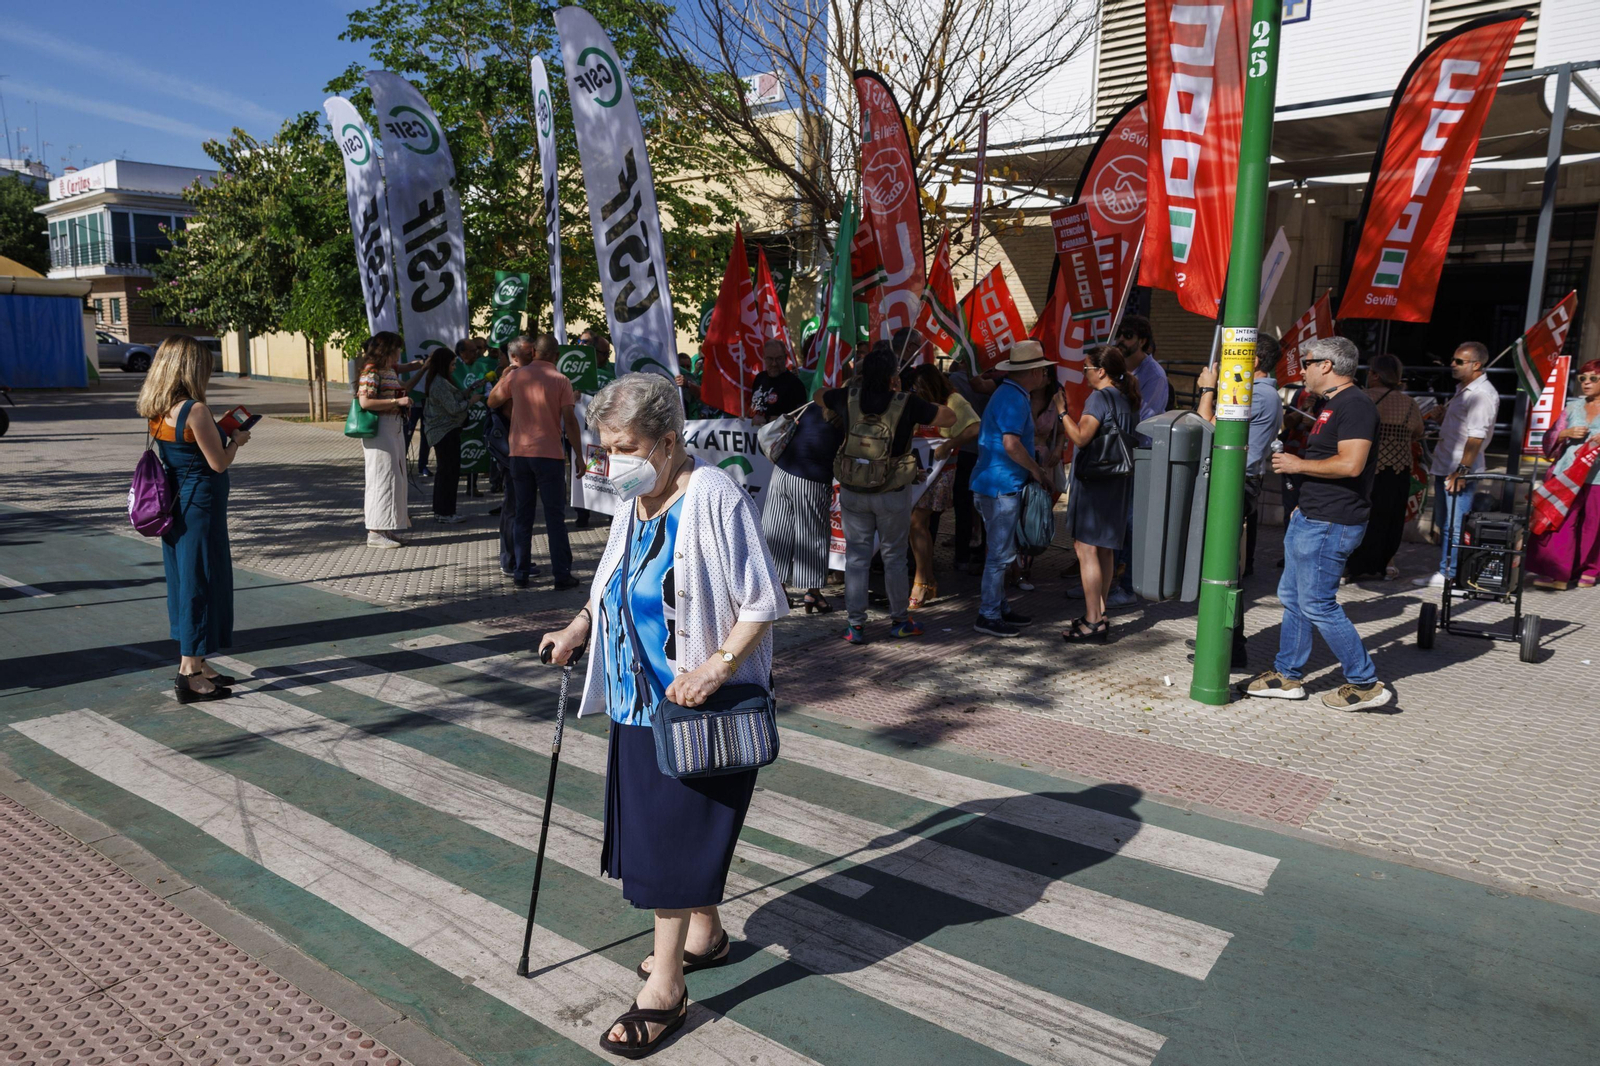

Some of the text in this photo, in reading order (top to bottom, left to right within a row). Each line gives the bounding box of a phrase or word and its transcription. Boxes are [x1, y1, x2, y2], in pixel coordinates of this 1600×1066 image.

[1249, 21, 1270, 78] 25
[1052, 212, 1089, 228] SALVEMOS LA
[1060, 224, 1086, 238] ATENCIÓN
[1062, 236, 1088, 250] PRIMARIA
[1071, 252, 1094, 309] CCOO
[499, 283, 524, 297] CSIF
[1364, 292, 1398, 306] Sevilla
[979, 272, 1016, 354] CCOO
[495, 322, 517, 335] CSIF
[977, 320, 997, 360] Sevilla
[561, 360, 591, 373] CSIF
[468, 409, 487, 420] SIF
[461, 447, 487, 459] CSIF
